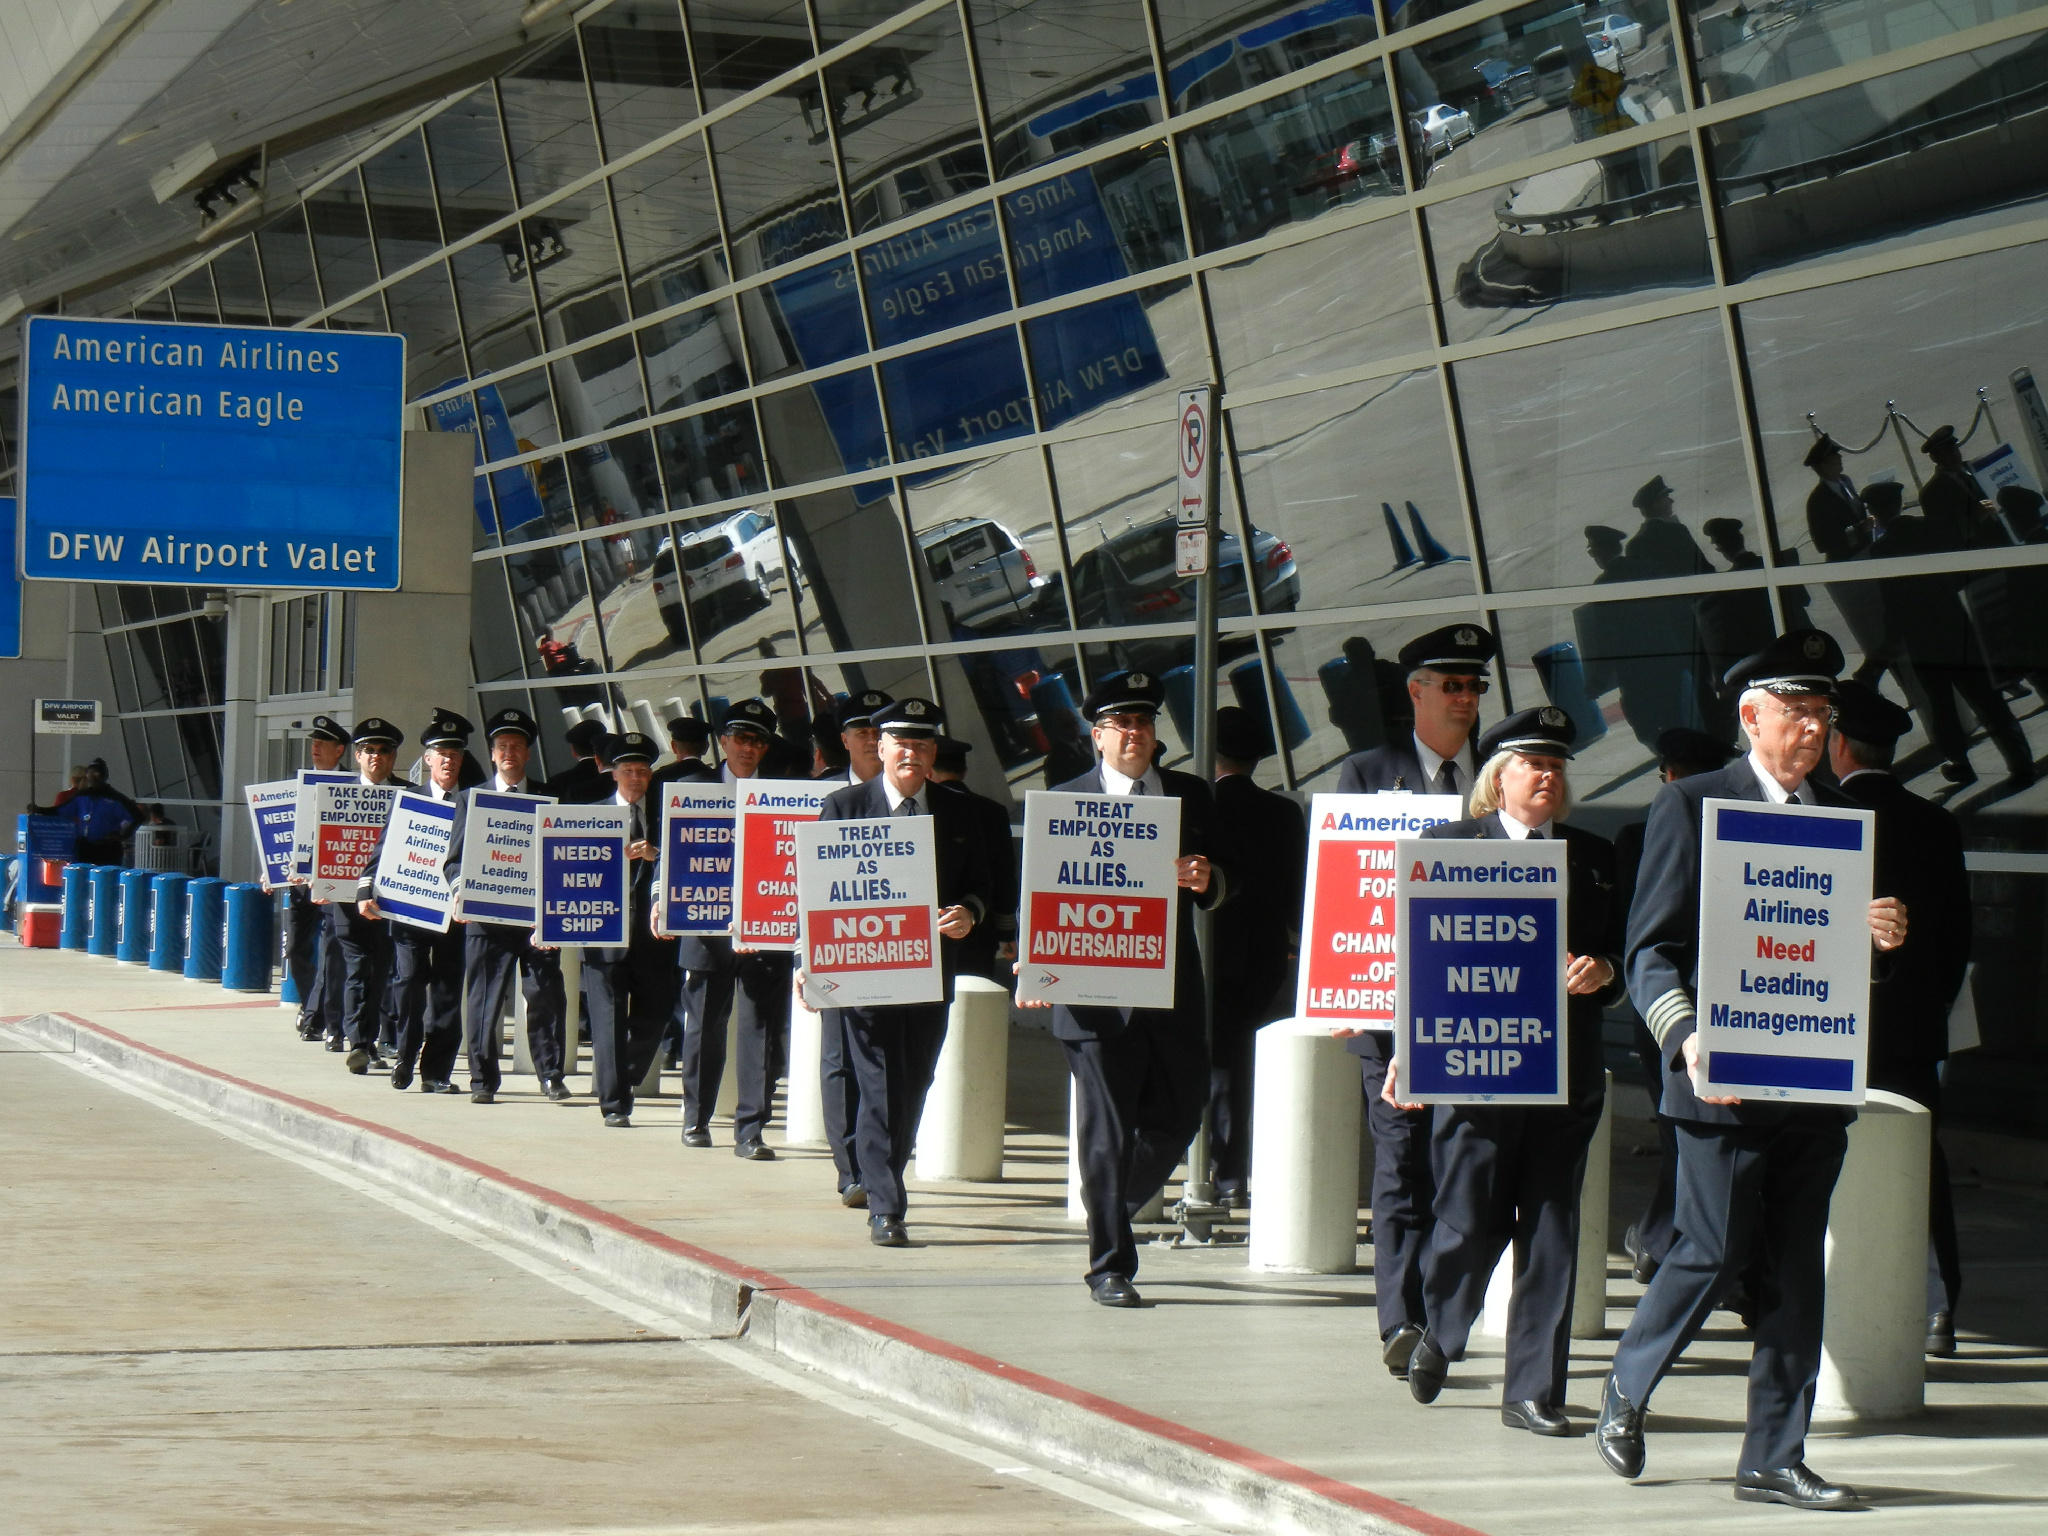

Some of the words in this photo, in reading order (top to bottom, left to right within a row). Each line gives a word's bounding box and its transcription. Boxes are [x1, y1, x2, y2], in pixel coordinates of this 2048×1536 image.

[53, 333, 203, 367] American
[219, 339, 340, 374] Airlines
[52, 383, 202, 417] American
[218, 391, 304, 427] Eagle
[49, 531, 124, 562] DFW
[141, 535, 268, 572] Airport
[286, 542, 377, 572] Valet
[328, 787, 357, 798] TAKE
[362, 788, 393, 800] CARE
[334, 800, 350, 810] OF
[354, 801, 386, 812] YOUR
[1074, 800, 1134, 819] TREAT
[321, 811, 387, 824] EMPLOYEES
[487, 817, 534, 835] Leading
[342, 829, 376, 840] WE'LL
[408, 819, 450, 841] Leading
[839, 825, 891, 841] TREAT
[1048, 819, 1158, 840] EMPLOYEES
[326, 841, 356, 852] TAKE
[405, 835, 446, 854] Airlines
[486, 833, 531, 848] Airlines
[817, 841, 914, 860] EMPLOYEES
[1090, 841, 1115, 858] AS
[336, 853, 352, 864] OF
[408, 851, 436, 867] Need
[491, 850, 522, 863] Need
[553, 845, 612, 861] NEEDS
[481, 864, 528, 882] Leading
[690, 857, 732, 872] NEW
[784, 861, 796, 876] A
[856, 860, 878, 875] AS
[1057, 861, 1144, 888] ALLIES...
[397, 864, 440, 886] Leading
[562, 873, 603, 888] NEW
[1744, 862, 1832, 896] Leading
[380, 876, 450, 902] Management
[671, 886, 734, 902] LEADE
[829, 878, 907, 902] ALLIES...
[545, 900, 620, 915] LEADER-
[687, 904, 731, 921] SHIP
[1058, 902, 1141, 930] NOT
[1370, 905, 1385, 926] A
[1744, 898, 1829, 927] Airlines
[561, 917, 603, 932] SHIP
[833, 914, 907, 938] NOT
[1429, 914, 1538, 943] NEEDS
[813, 939, 929, 966] ADVERSARIES!
[1032, 931, 1162, 960] ADVERSARIES!
[1756, 935, 1815, 962] Need
[1350, 961, 1396, 983] ...OF
[1447, 966, 1521, 993] NEW
[1740, 968, 1829, 1002] Leading
[1309, 987, 1395, 1012] LEADERS
[1710, 1003, 1856, 1035] Management
[1415, 1017, 1552, 1044] LEADER-
[1445, 1049, 1522, 1076] SHIP
